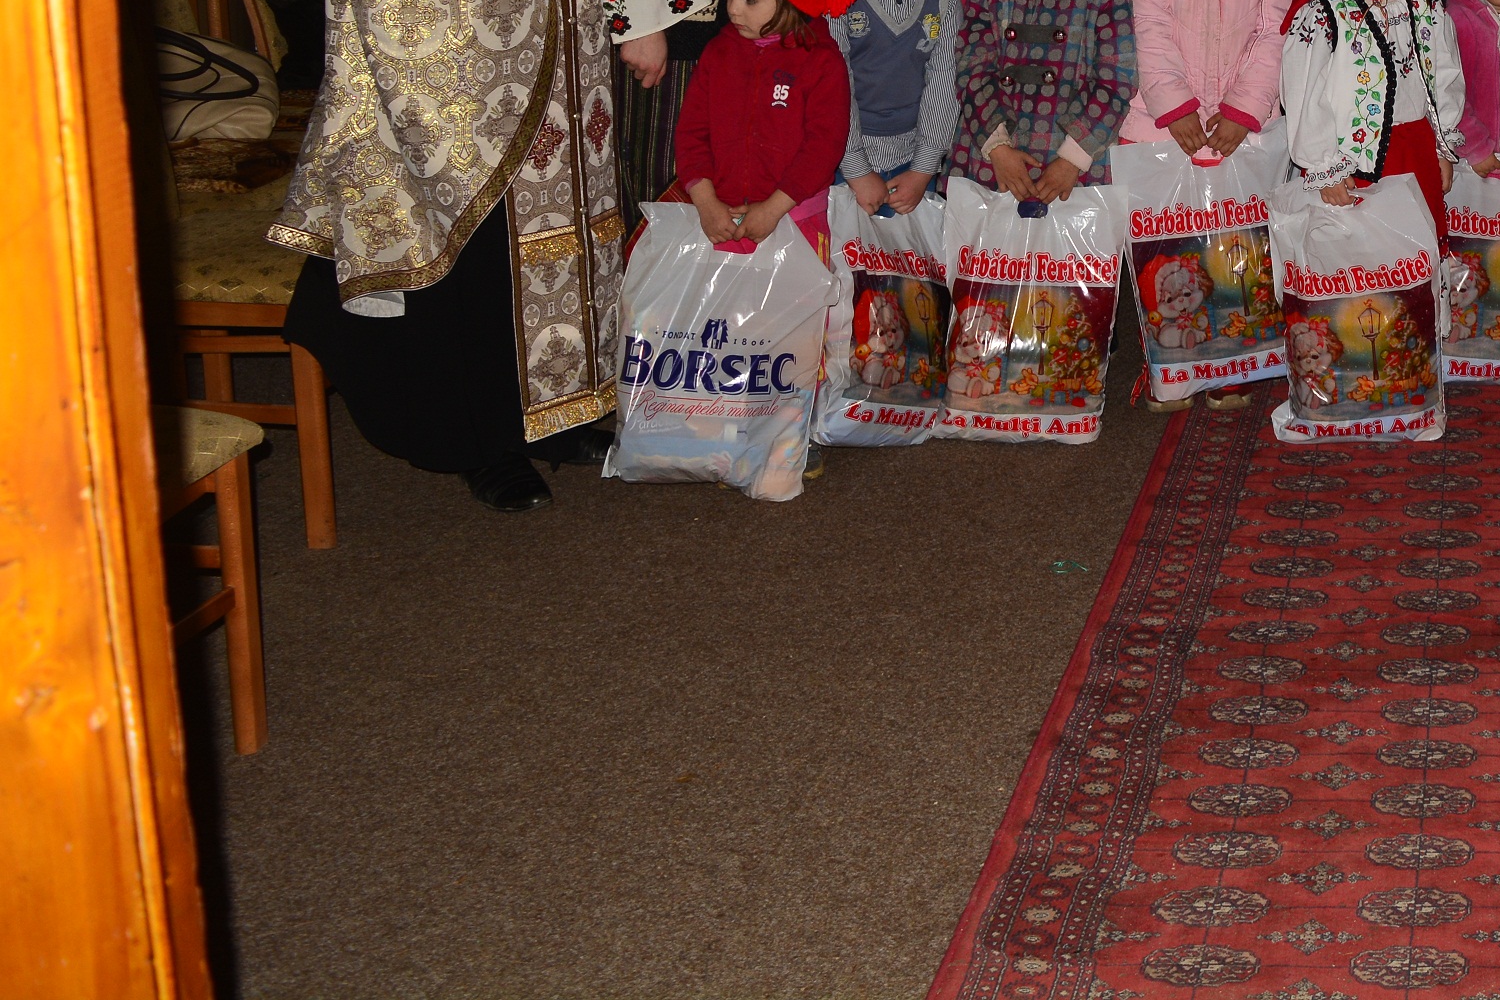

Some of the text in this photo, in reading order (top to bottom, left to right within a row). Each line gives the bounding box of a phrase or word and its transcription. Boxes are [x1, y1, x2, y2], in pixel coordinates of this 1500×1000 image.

[772, 84, 790, 101] 85
[1130, 202, 1220, 239] Sărbători
[1034, 251, 1119, 284] Fericite!
[1349, 249, 1433, 292] Fericite!
[661, 330, 696, 341] FONDAT
[620, 335, 797, 396] BORSEC
[1159, 366, 1190, 385] La
[632, 389, 781, 422] Regina apelor minerale
[844, 401, 875, 423] La
[1045, 414, 1099, 435] Ani!
